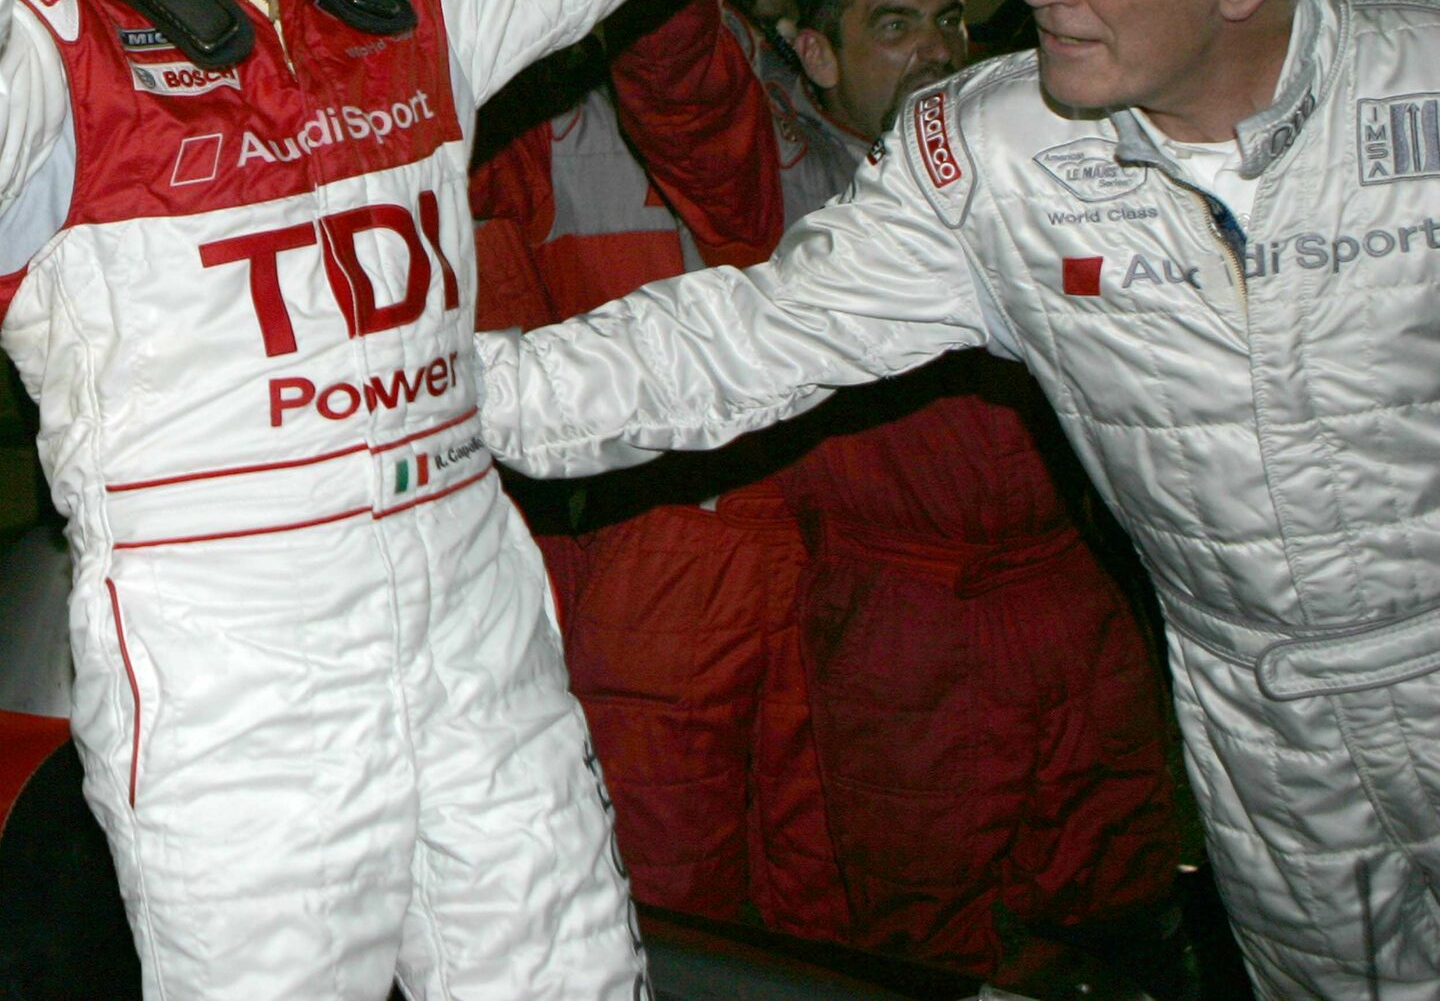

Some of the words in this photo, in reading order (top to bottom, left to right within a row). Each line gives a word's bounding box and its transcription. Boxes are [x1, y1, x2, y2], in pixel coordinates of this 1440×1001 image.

[237, 107, 344, 167] Audi
[342, 90, 435, 144] Sport
[1047, 211, 1100, 226] World
[1106, 207, 1159, 222] Class
[1294, 217, 1440, 274] Sport
[199, 189, 460, 358] TDI
[268, 350, 458, 428] Power
